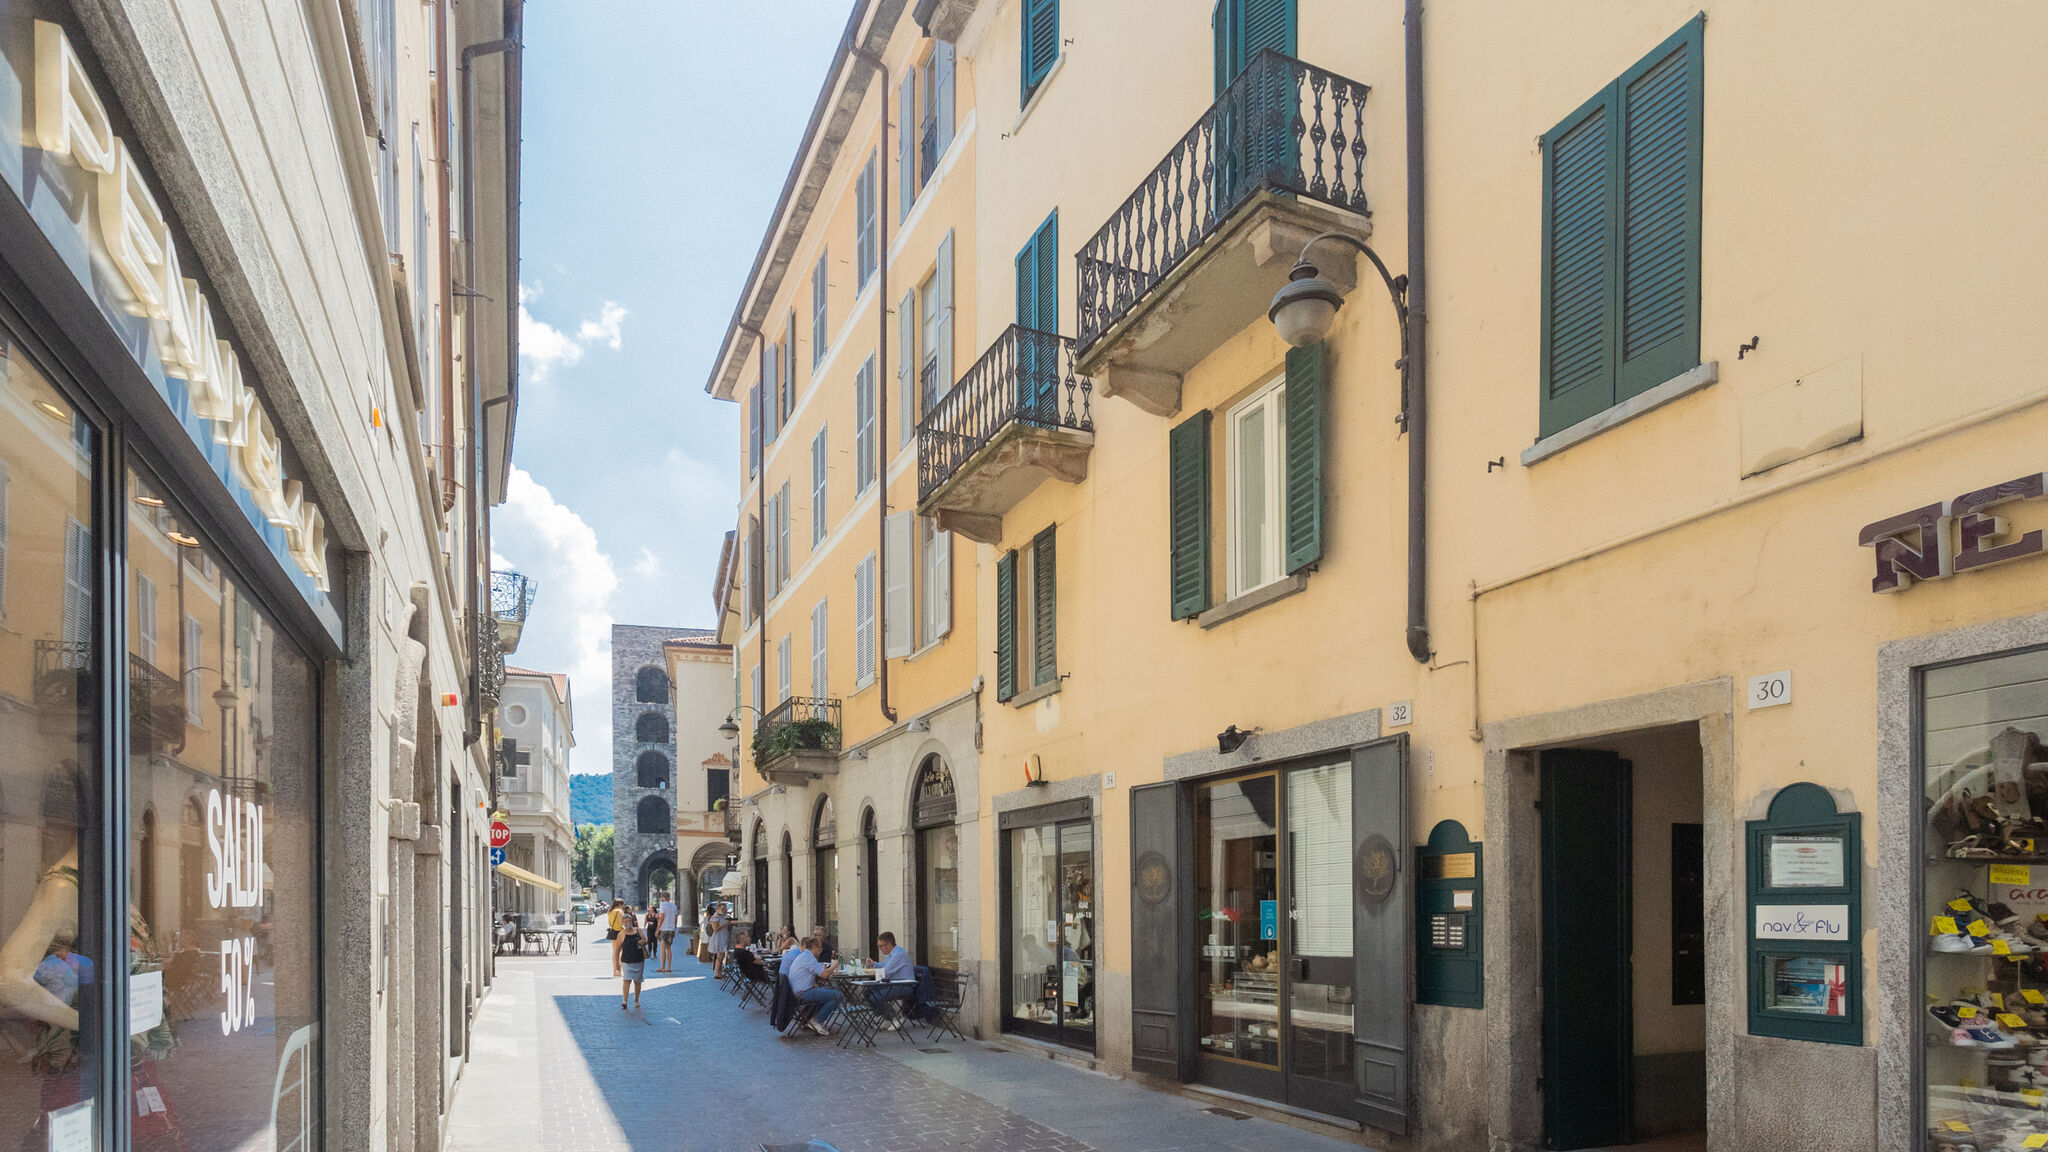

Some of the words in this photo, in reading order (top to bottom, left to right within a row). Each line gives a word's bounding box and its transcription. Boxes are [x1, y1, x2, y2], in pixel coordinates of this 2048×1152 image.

[1757, 679, 1784, 701] 30
[1393, 705, 1407, 721] 32
[490, 829, 509, 840] TOP
[207, 789, 264, 909] SALDI
[1762, 922, 1792, 933] nav
